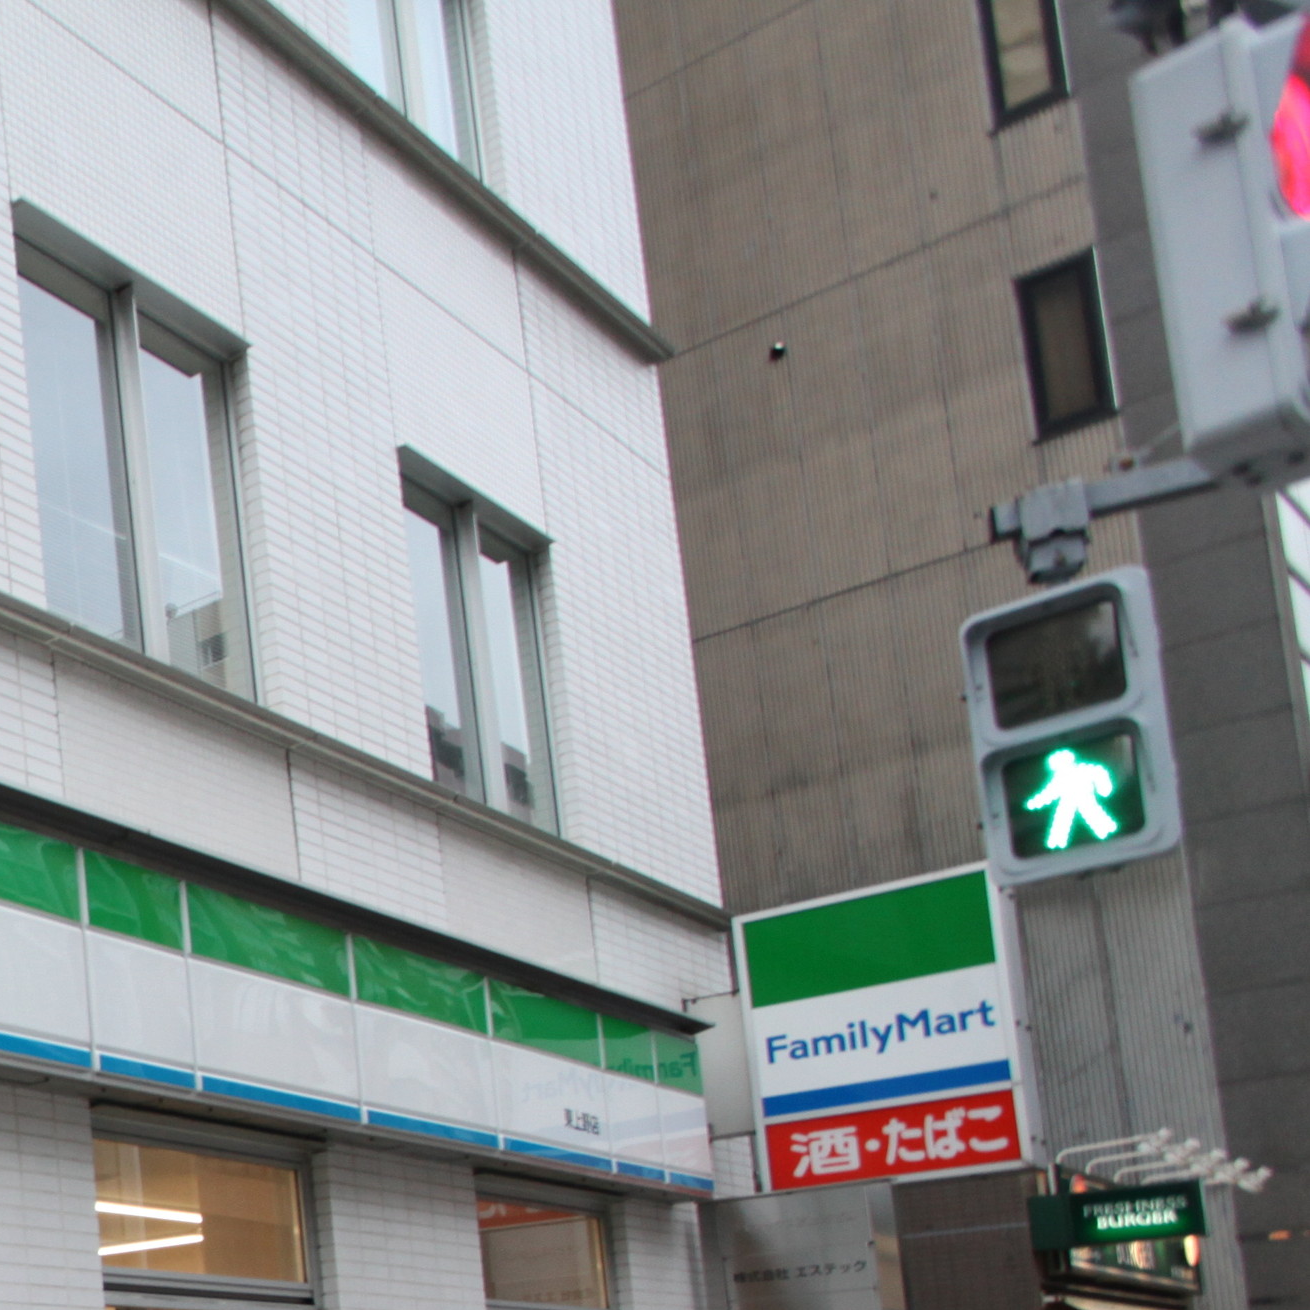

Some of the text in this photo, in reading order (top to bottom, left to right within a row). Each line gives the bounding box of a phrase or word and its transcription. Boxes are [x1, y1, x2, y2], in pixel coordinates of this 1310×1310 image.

[766, 1000, 996, 1065] FamilyMart
[790, 1105, 1010, 1178] 酒・たばこ
[1096, 1209, 1178, 1231] BURGER
